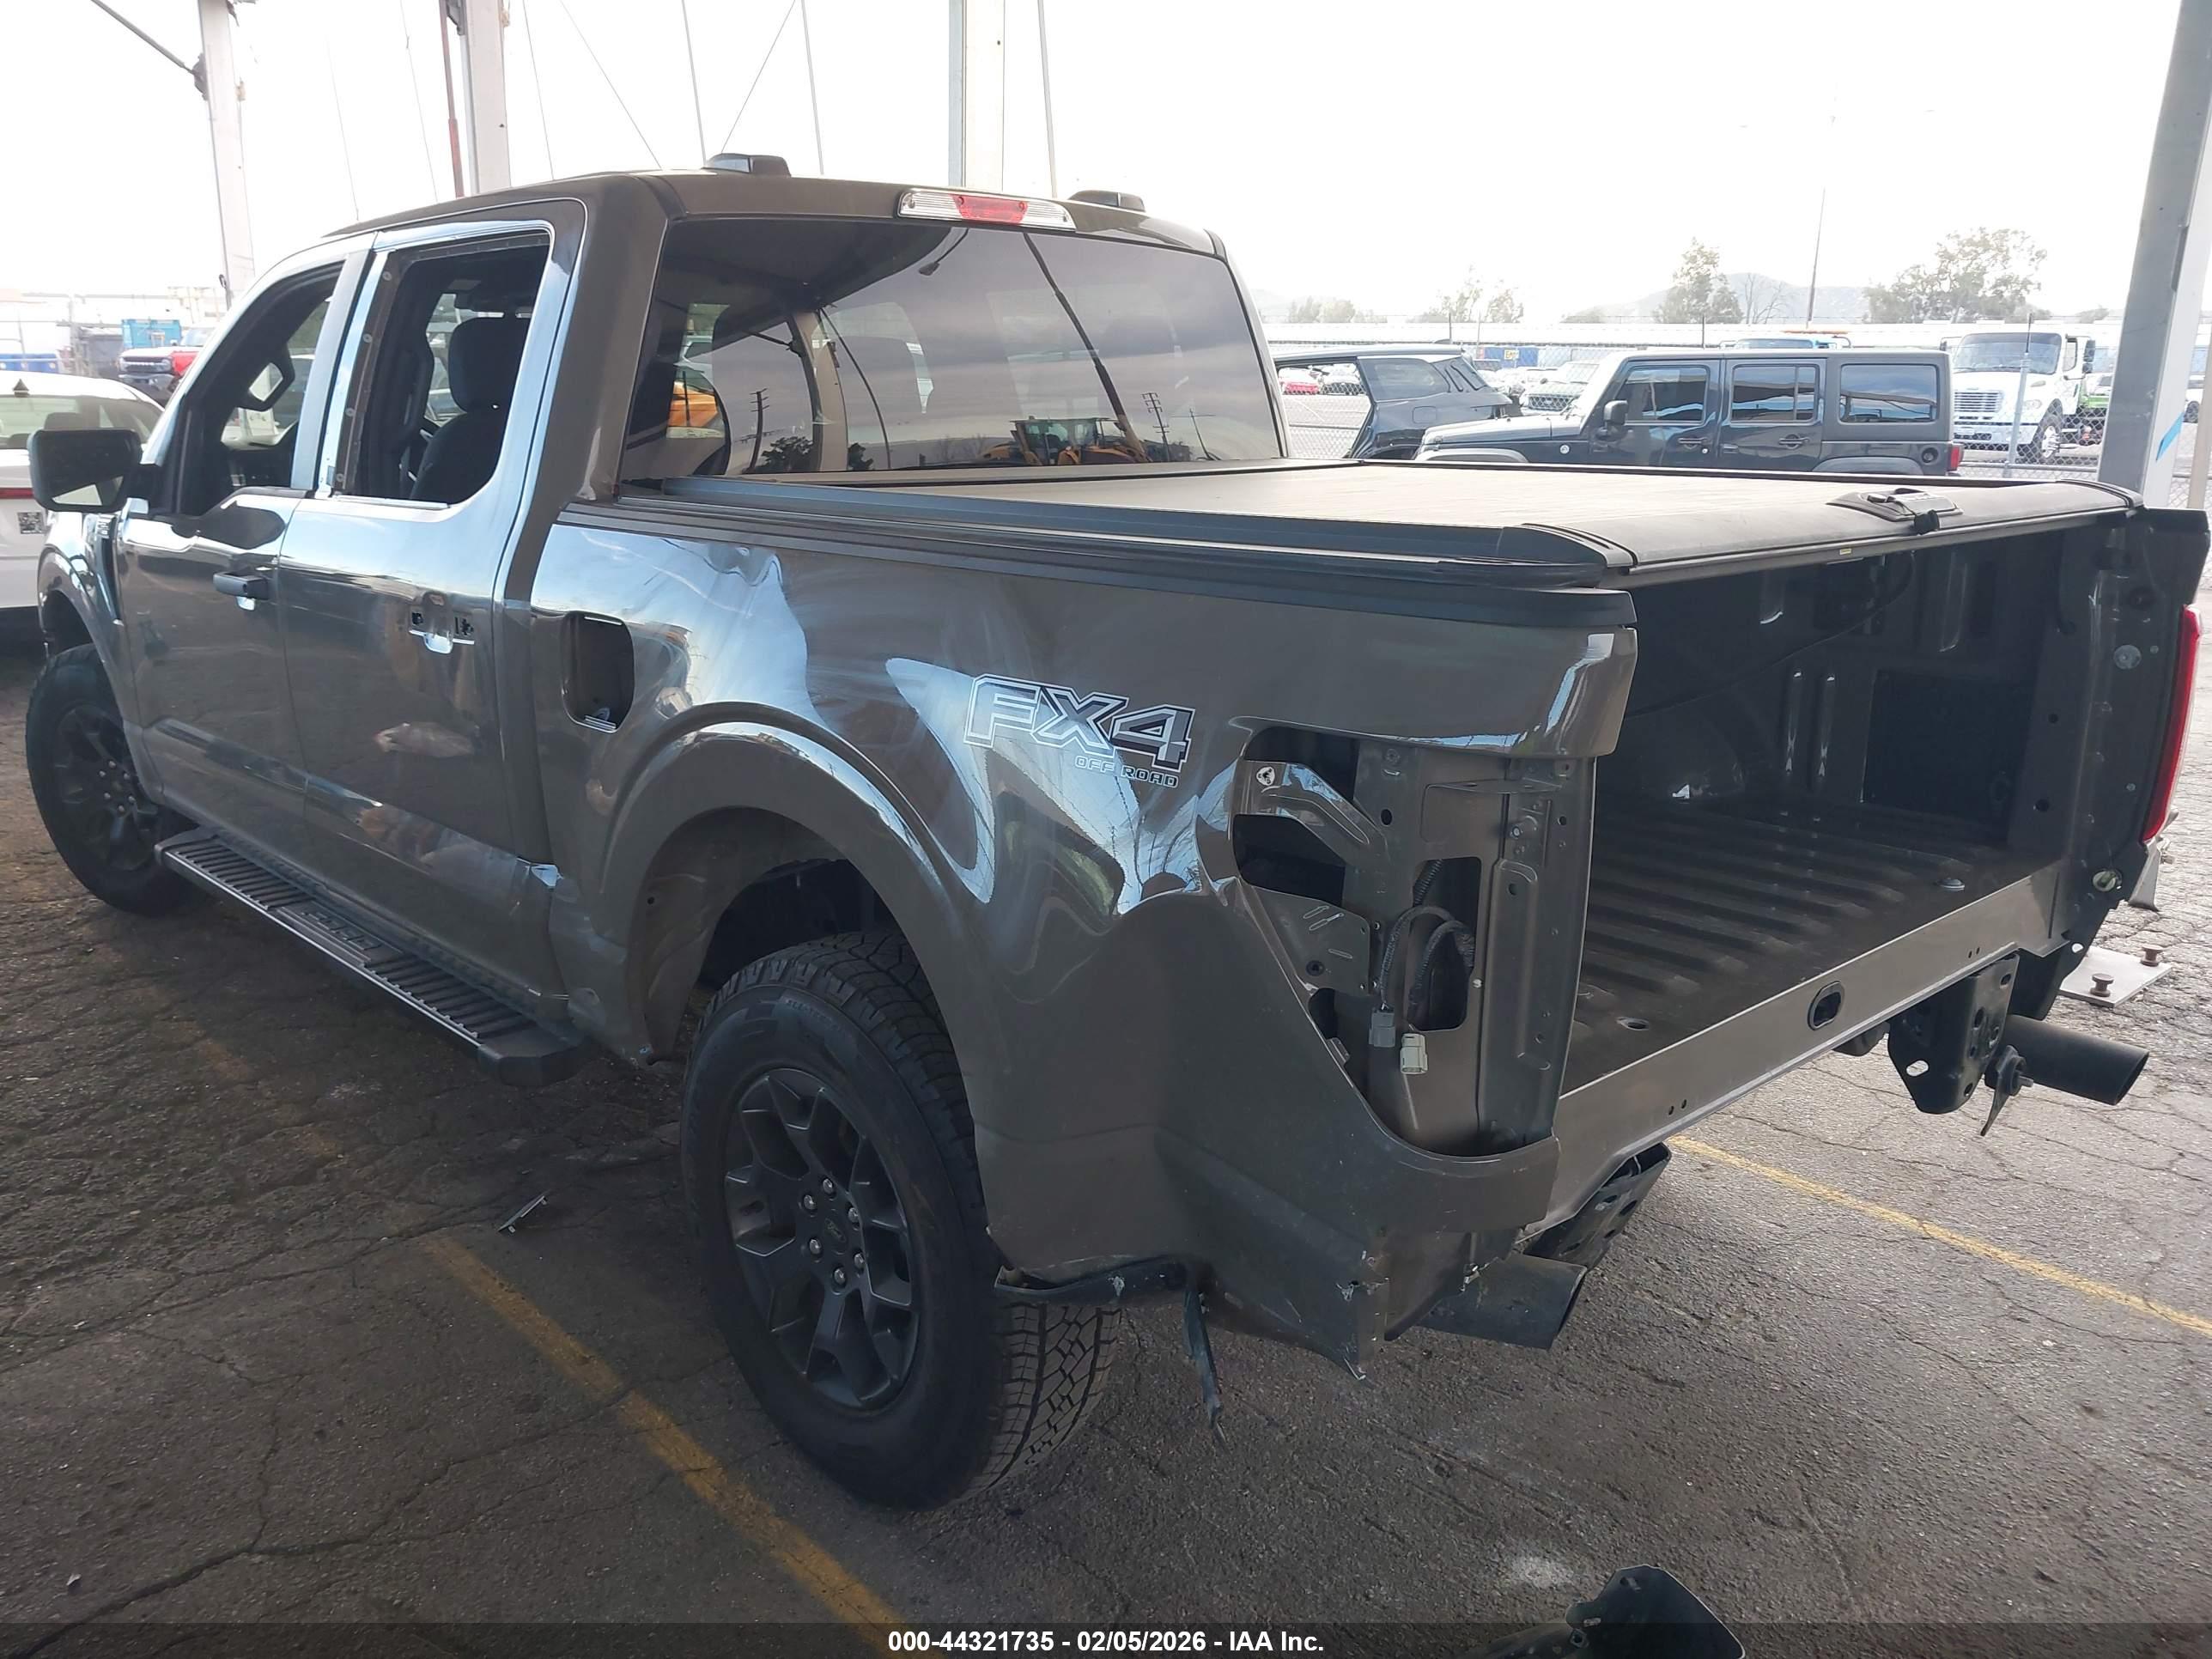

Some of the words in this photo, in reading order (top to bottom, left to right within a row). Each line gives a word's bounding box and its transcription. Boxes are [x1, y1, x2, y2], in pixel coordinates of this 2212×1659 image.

[964, 673, 1196, 772] FX4
[1075, 755, 1115, 774] OFF
[1121, 766, 1179, 788] ROAD
